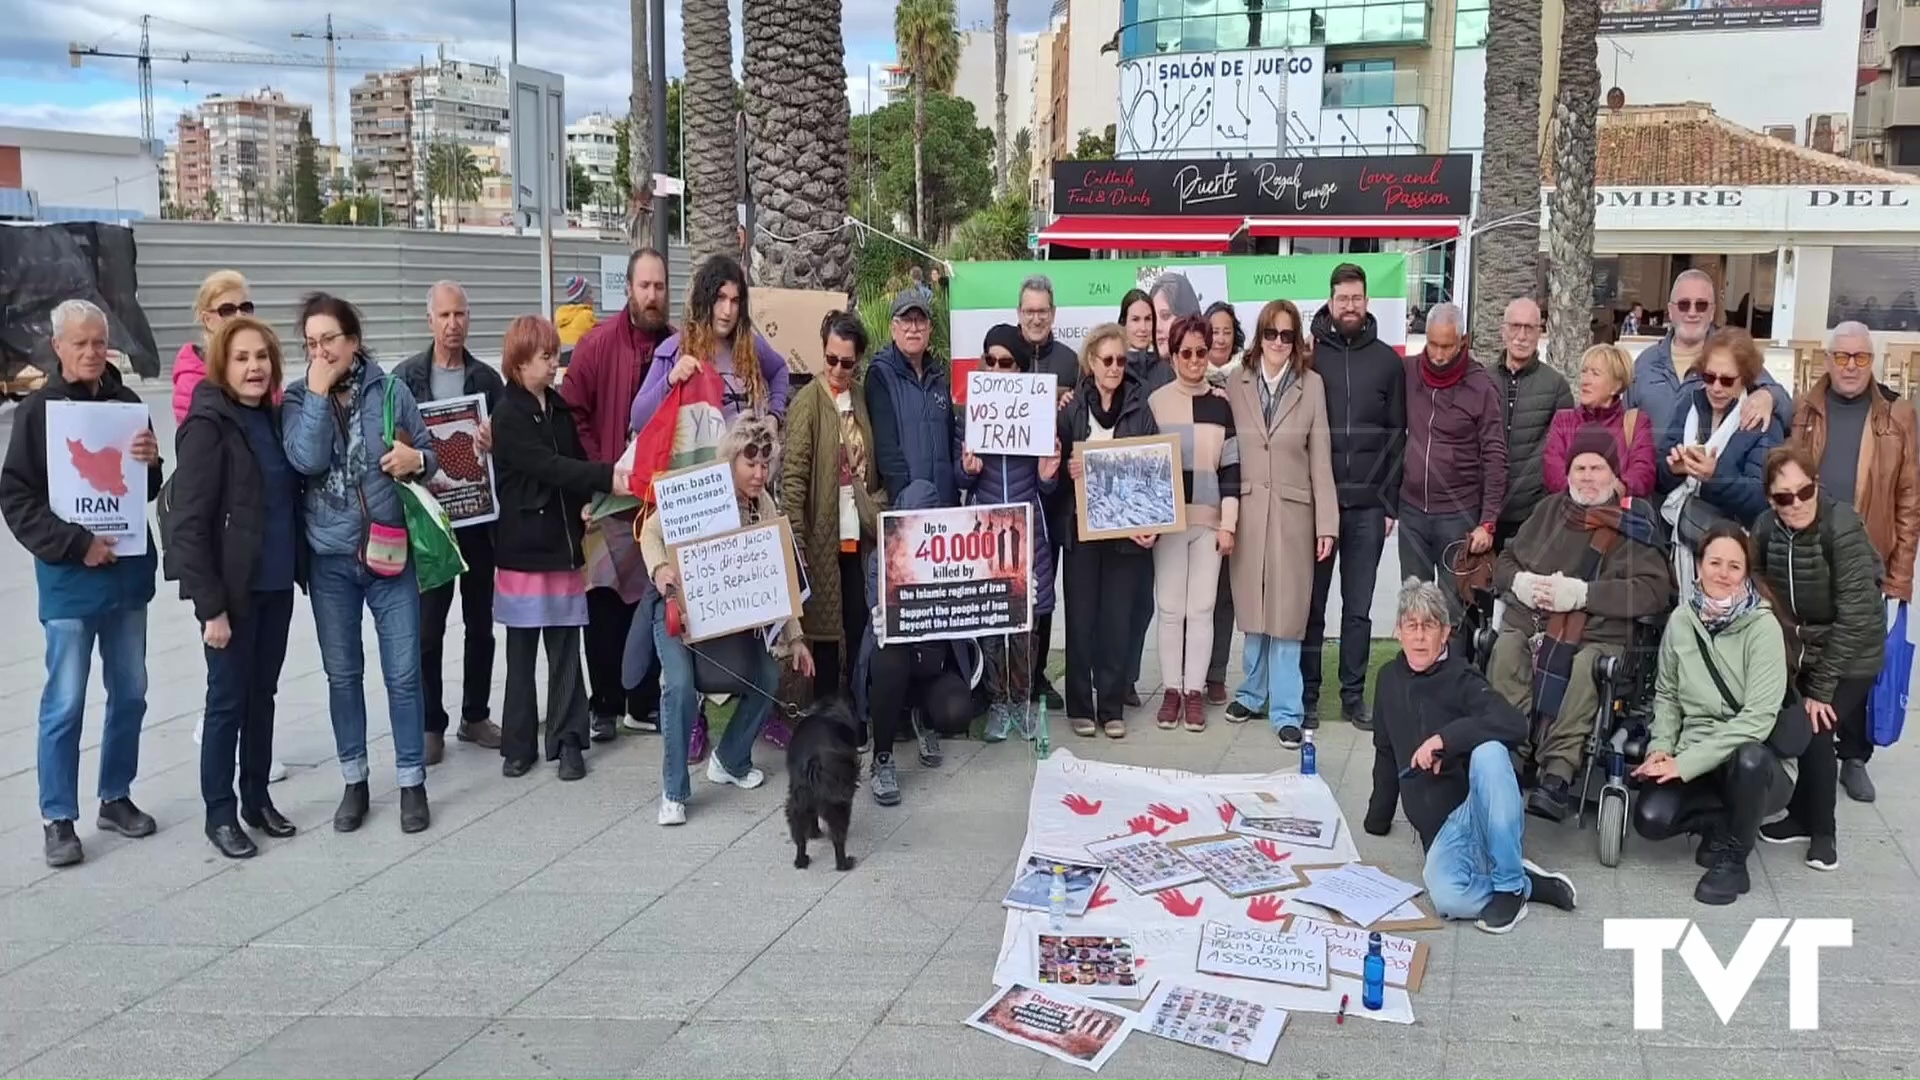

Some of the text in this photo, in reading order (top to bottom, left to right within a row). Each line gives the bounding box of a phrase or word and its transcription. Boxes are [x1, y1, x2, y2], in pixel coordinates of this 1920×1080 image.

[1158, 55, 1313, 80] SALÓN DE JUEGO
[1083, 167, 1136, 188] Cocktails
[1359, 157, 1440, 192] Love and
[1172, 161, 1239, 213] Puerto
[1253, 162, 1338, 211] Royal Lounge
[1109, 188, 1153, 208] Drinks
[1382, 184, 1450, 214] Passion
[1546, 189, 1910, 207] MBRE DEL
[1088, 281, 1111, 295] ZAN
[1252, 273, 1296, 285] WOMAN
[971, 373, 1024, 395] Somos
[1005, 395, 1030, 420] de
[980, 423, 1031, 449] IRAN
[690, 472, 723, 490] basta
[75, 497, 119, 513] IRAN
[662, 499, 674, 511] de
[667, 528, 677, 539] in
[923, 522, 948, 536] Up to
[933, 564, 975, 579] killed by
[687, 584, 704, 602] de
[900, 590, 914, 601] the
[979, 583, 989, 594] of
[990, 583, 1006, 593] Iran
[900, 600, 1009, 619] Support the people of Iran
[900, 619, 932, 632] Boycott
[933, 618, 948, 629] the
[1030, 993, 1075, 1012] Danger
